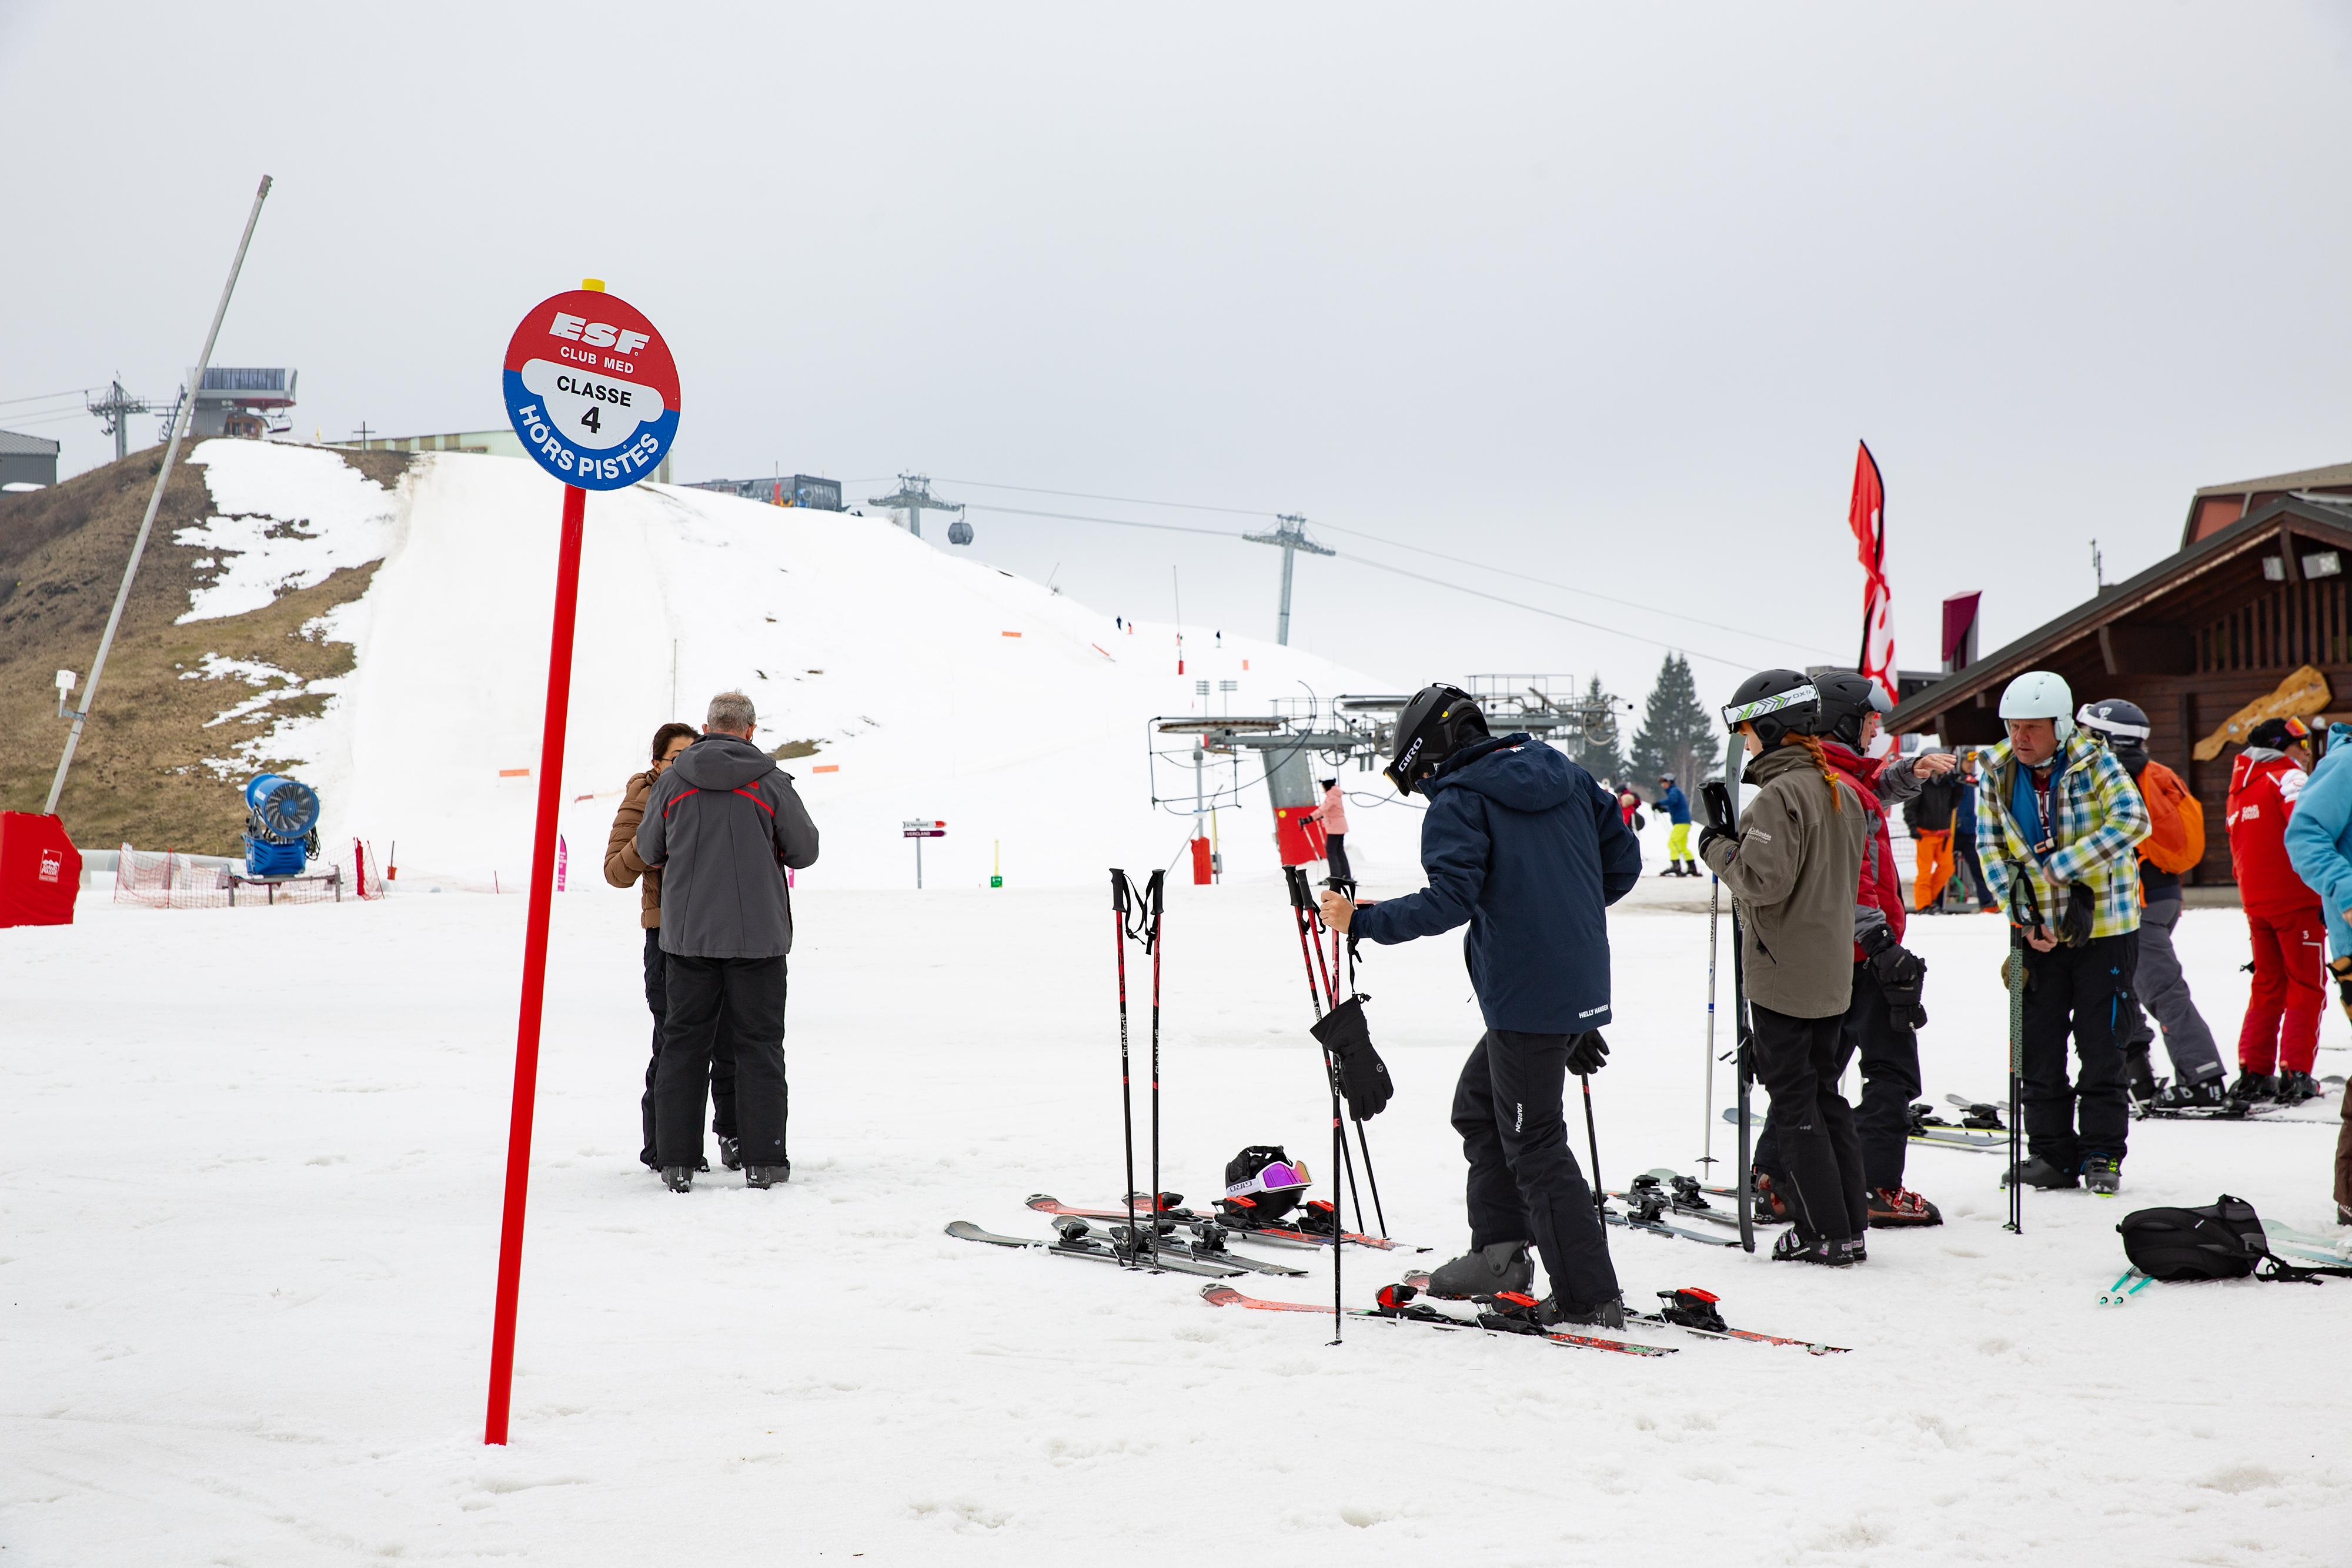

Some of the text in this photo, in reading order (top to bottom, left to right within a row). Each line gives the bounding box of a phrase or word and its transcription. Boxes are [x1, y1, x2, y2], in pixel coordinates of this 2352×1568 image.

[549, 312, 650, 355] ESF
[560, 346, 634, 374] CLUB MED
[557, 376, 632, 407] CLASSE
[581, 406, 601, 434] 4
[519, 404, 659, 479] HORS PISTES
[1398, 737, 1423, 772] GIRO
[1750, 827, 1772, 838] Columbia
[1579, 1004, 1609, 1018] HELLY HANSEN
[1230, 1181, 1252, 1192] GIRO
[1790, 1247, 1810, 1257] SALOMON
